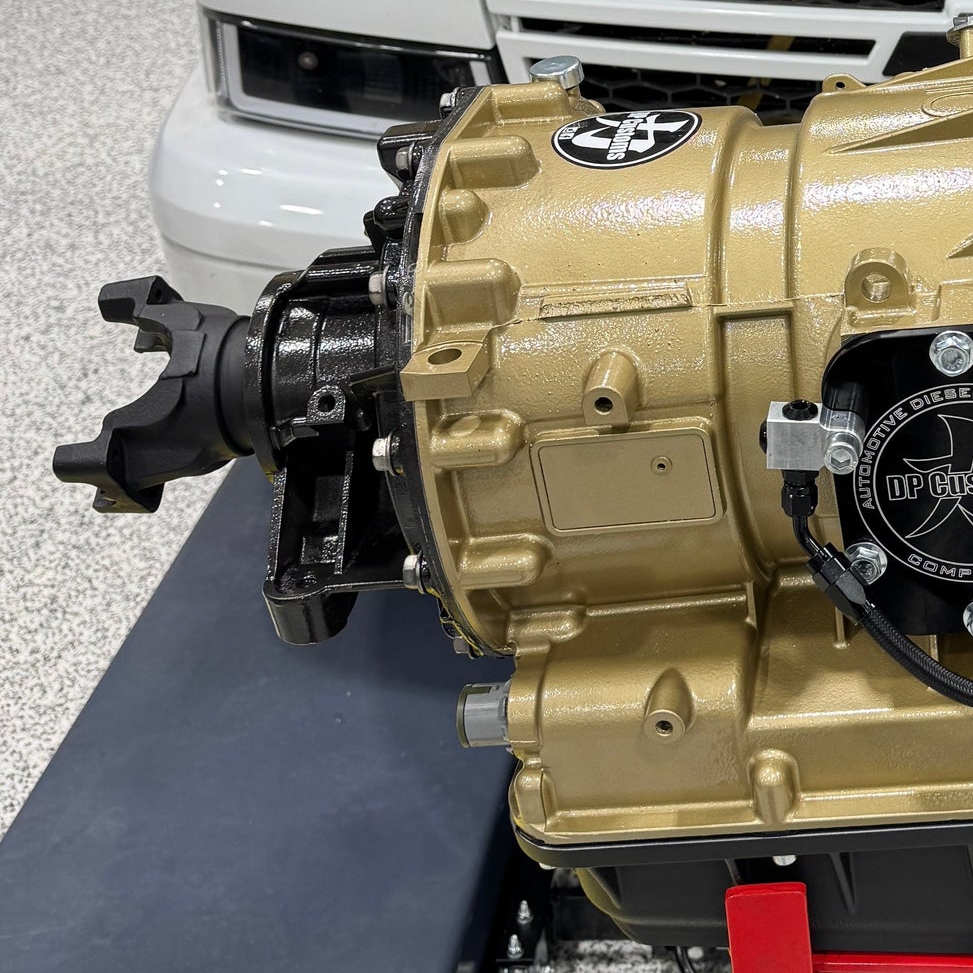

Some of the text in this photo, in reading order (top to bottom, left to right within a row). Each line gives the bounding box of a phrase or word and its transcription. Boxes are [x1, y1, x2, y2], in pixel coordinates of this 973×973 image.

[861, 407, 908, 510] AUTOMOTIVE
[886, 474, 924, 501] DP
[907, 553, 973, 578] COMP
